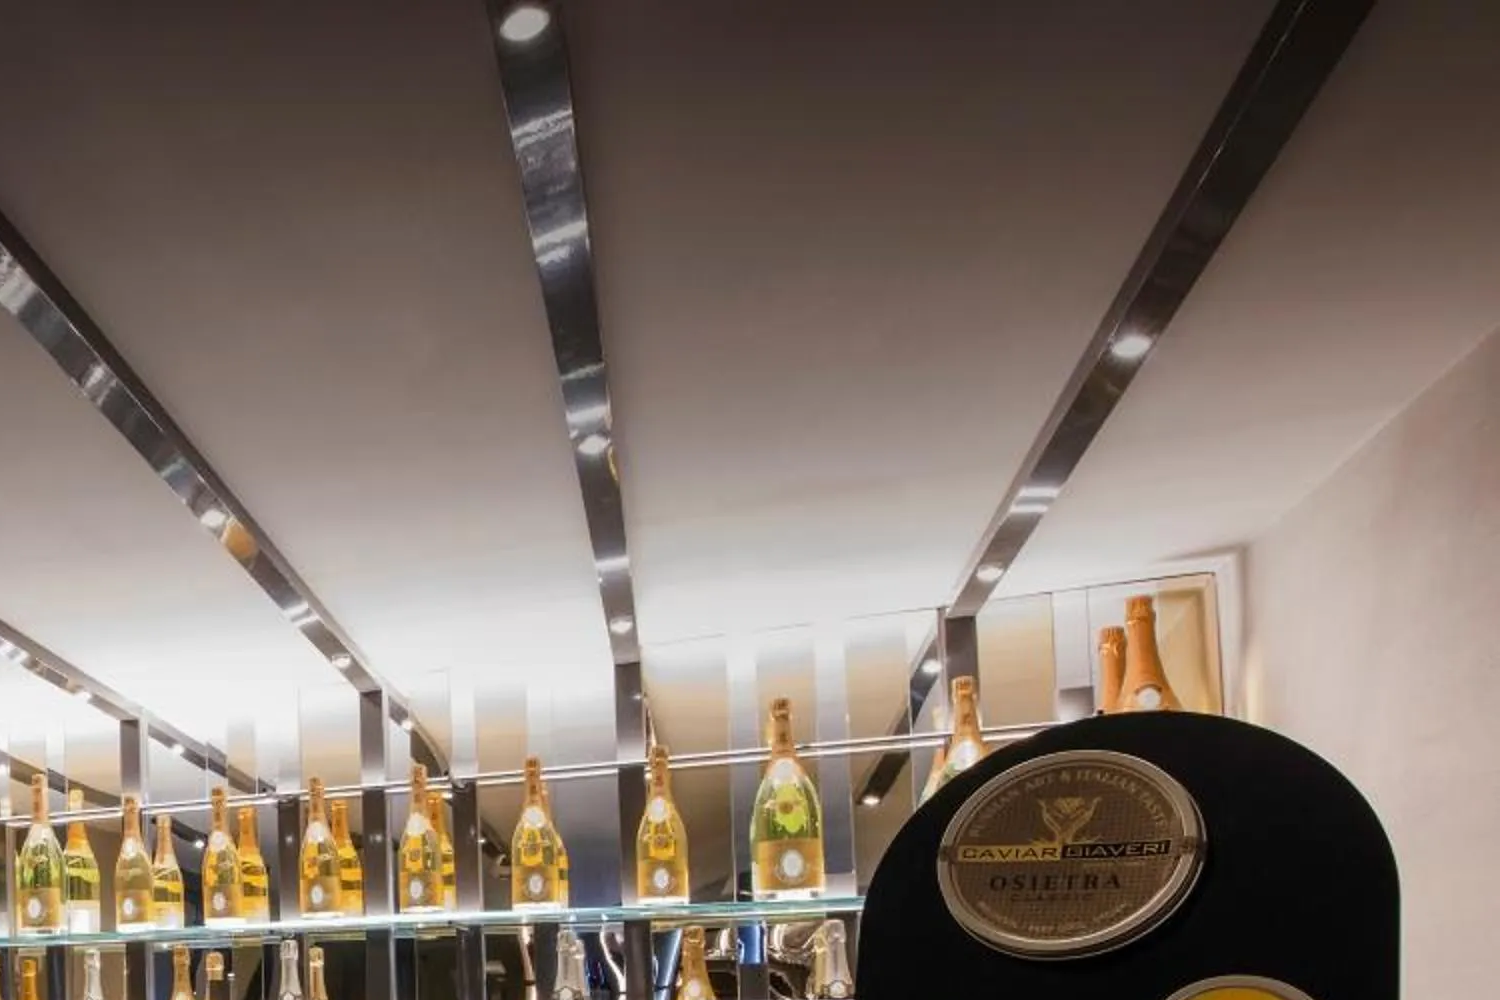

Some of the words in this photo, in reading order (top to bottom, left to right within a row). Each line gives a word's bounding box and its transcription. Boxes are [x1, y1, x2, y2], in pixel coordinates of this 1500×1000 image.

[962, 846, 1058, 859] CAVIAR
[1064, 843, 1166, 858] GIAVERI
[989, 873, 1122, 892] OSIETRA
